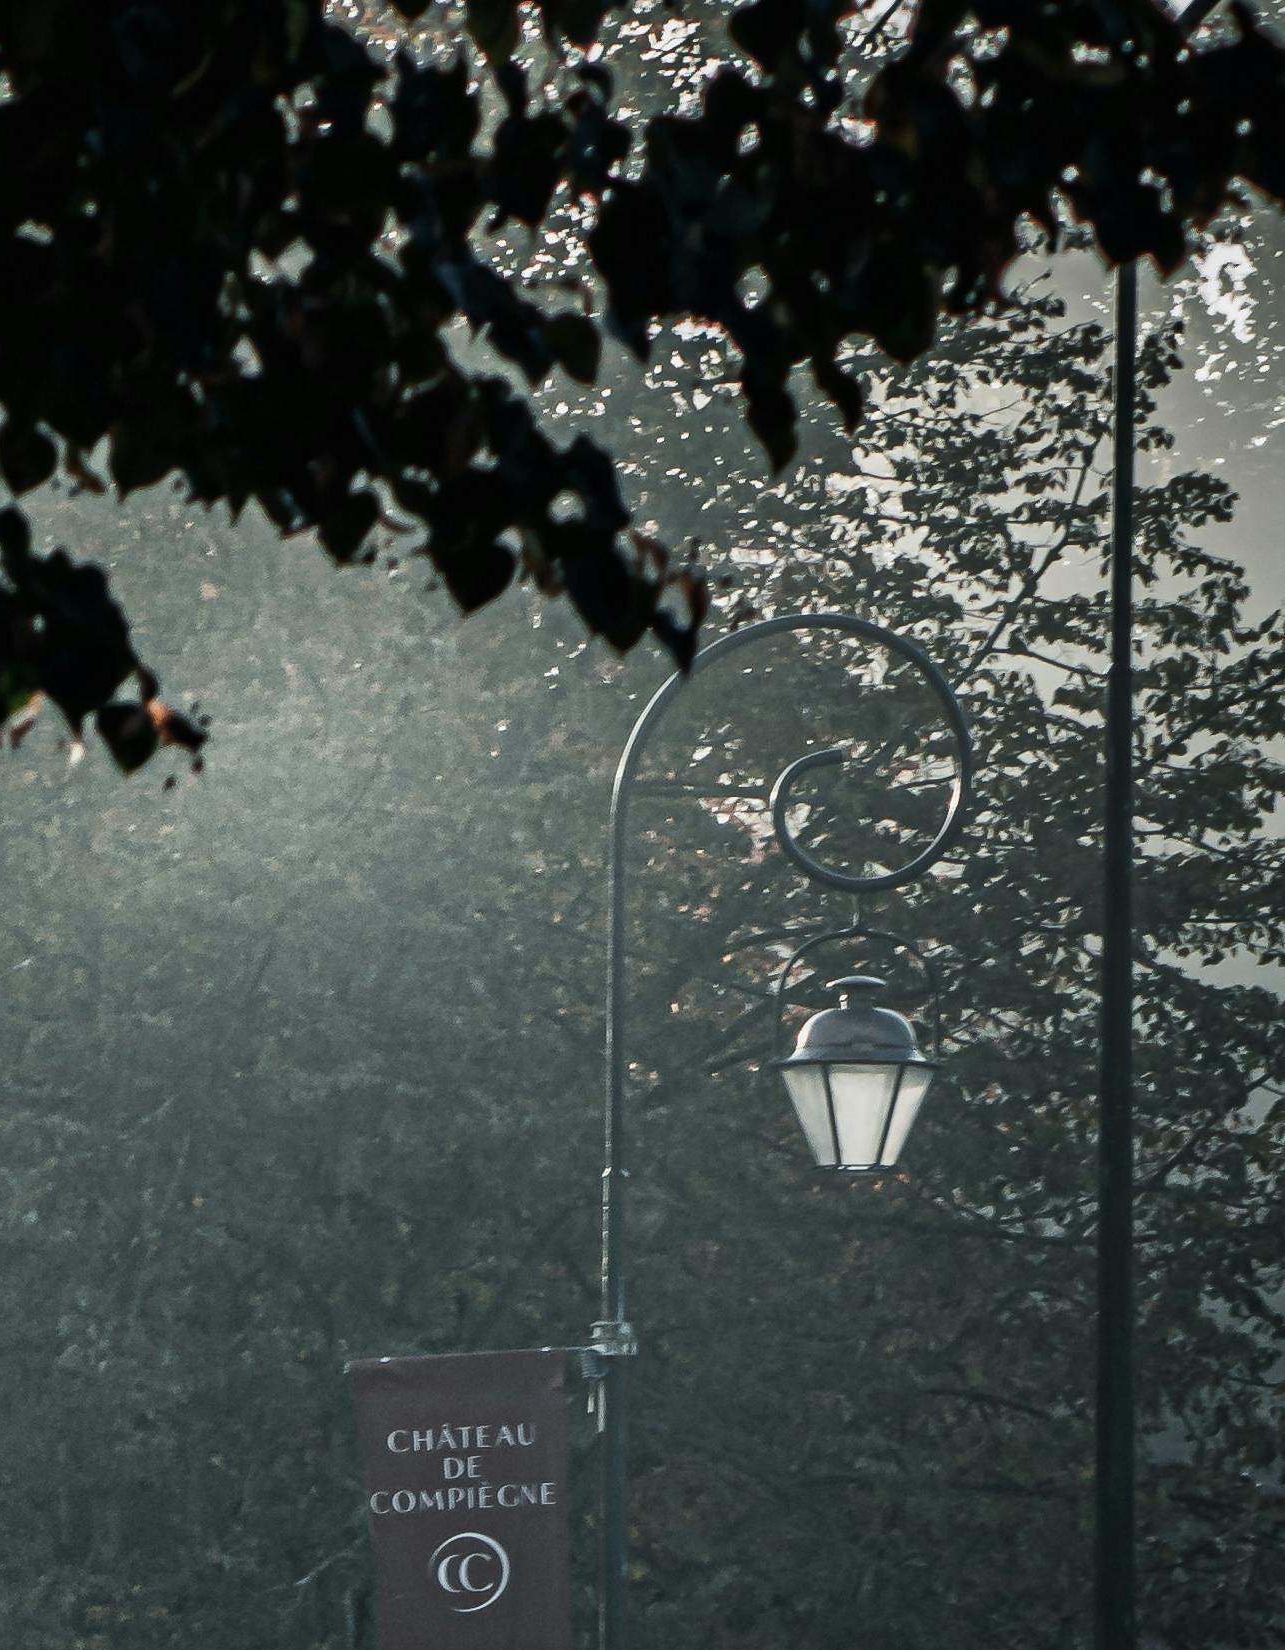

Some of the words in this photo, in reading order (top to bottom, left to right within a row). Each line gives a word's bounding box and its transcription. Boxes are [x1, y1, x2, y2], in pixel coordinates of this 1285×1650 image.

[387, 1423, 537, 1453] CHÂTEAU
[443, 1455, 482, 1480] DE
[369, 1480, 557, 1514] COMPIÈGNE
